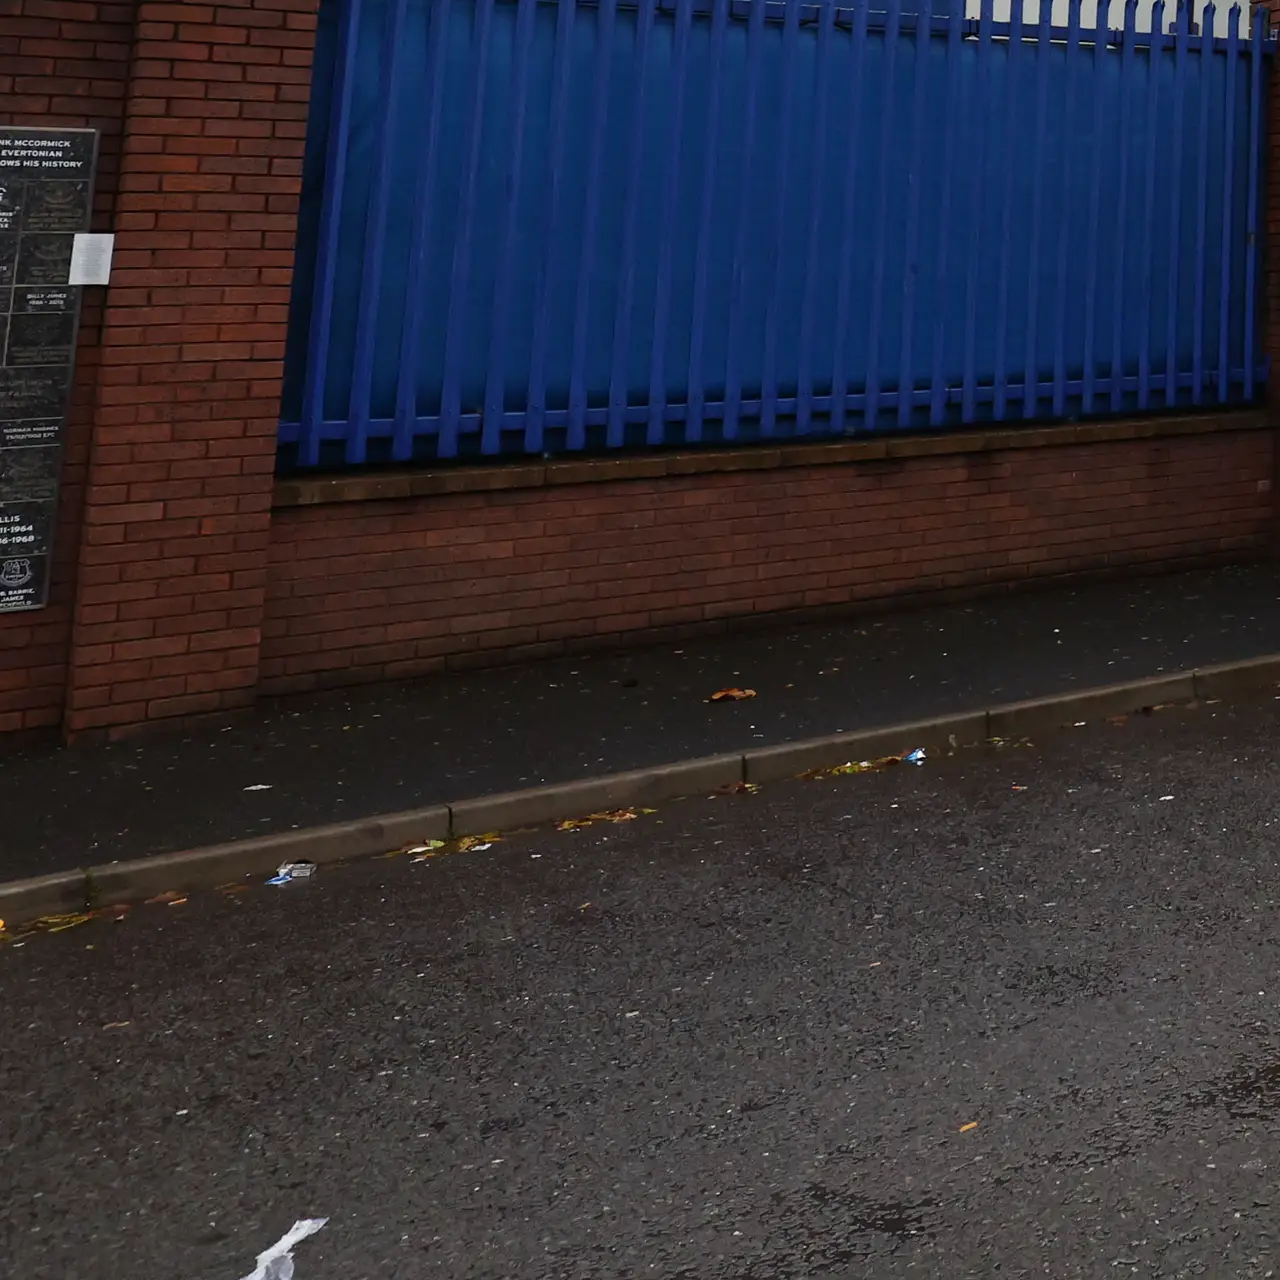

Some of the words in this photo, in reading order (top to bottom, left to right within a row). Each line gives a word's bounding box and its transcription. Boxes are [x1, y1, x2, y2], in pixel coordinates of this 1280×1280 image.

[14, 139, 71, 147] MCCORMICK
[1, 149, 63, 157] EVERTONIAN
[42, 160, 84, 168] HISTORY
